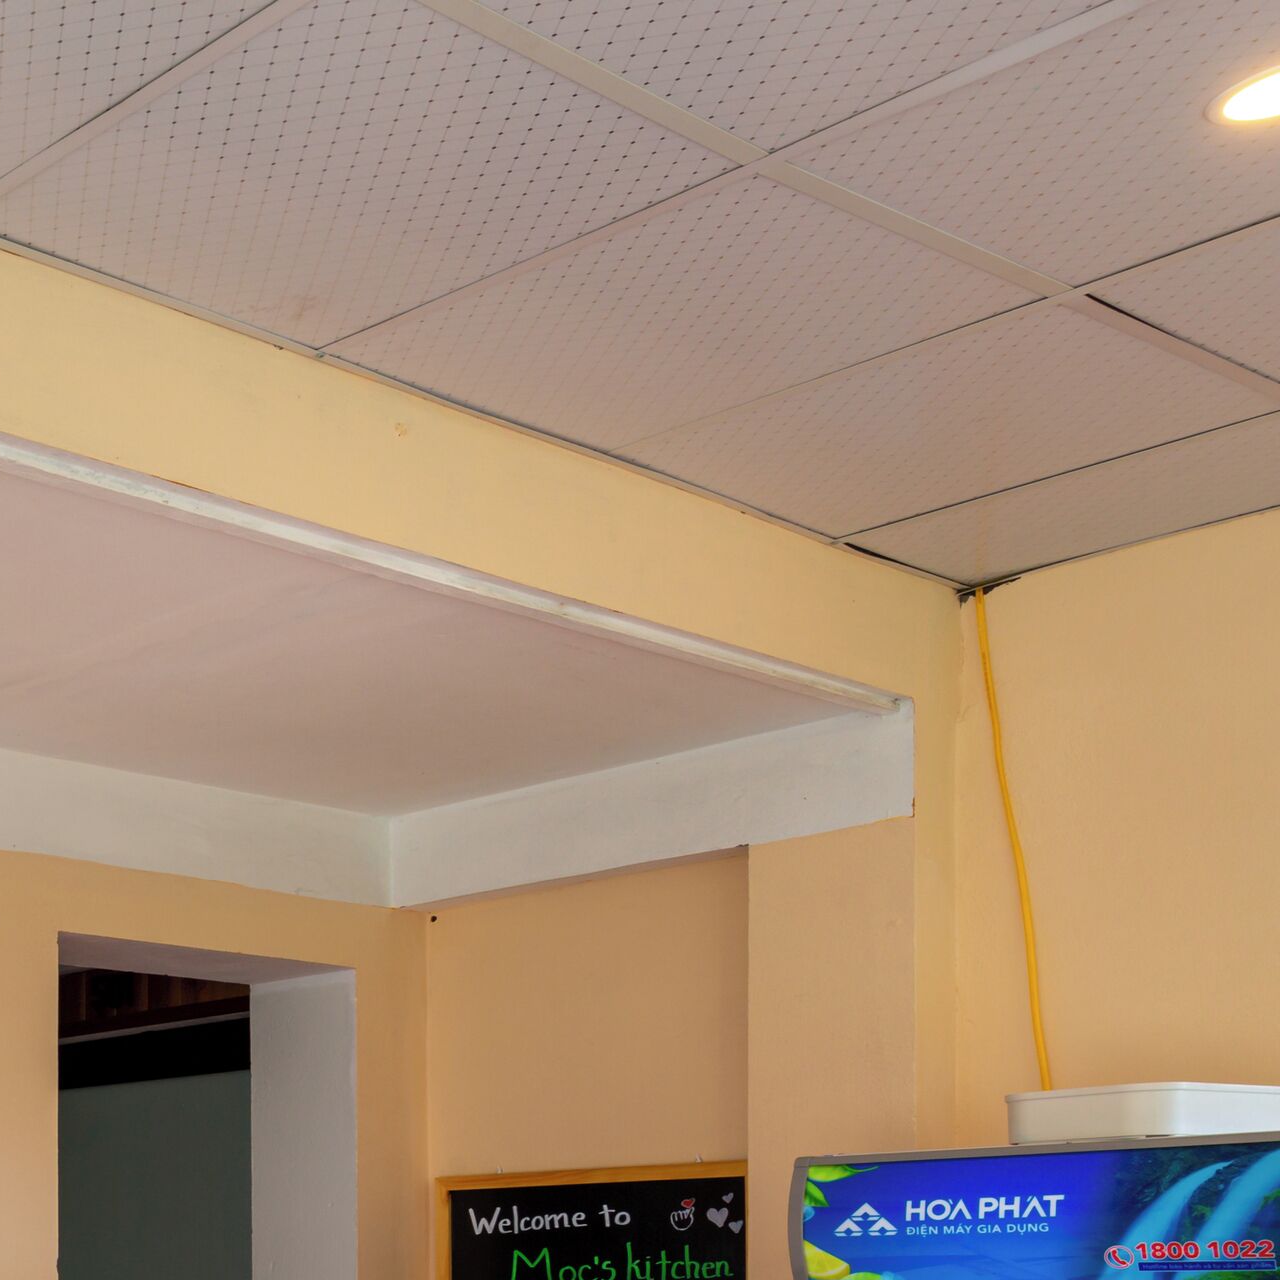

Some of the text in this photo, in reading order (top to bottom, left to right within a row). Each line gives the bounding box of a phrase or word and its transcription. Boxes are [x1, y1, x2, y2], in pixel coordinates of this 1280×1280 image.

[978, 1194, 1065, 1219] PHÁT
[468, 1204, 631, 1236] Welcome to
[906, 1222, 1049, 1237] ĐIỆN MÁY GIA DỤNG
[1135, 1239, 1276, 1260] 1800 1022
